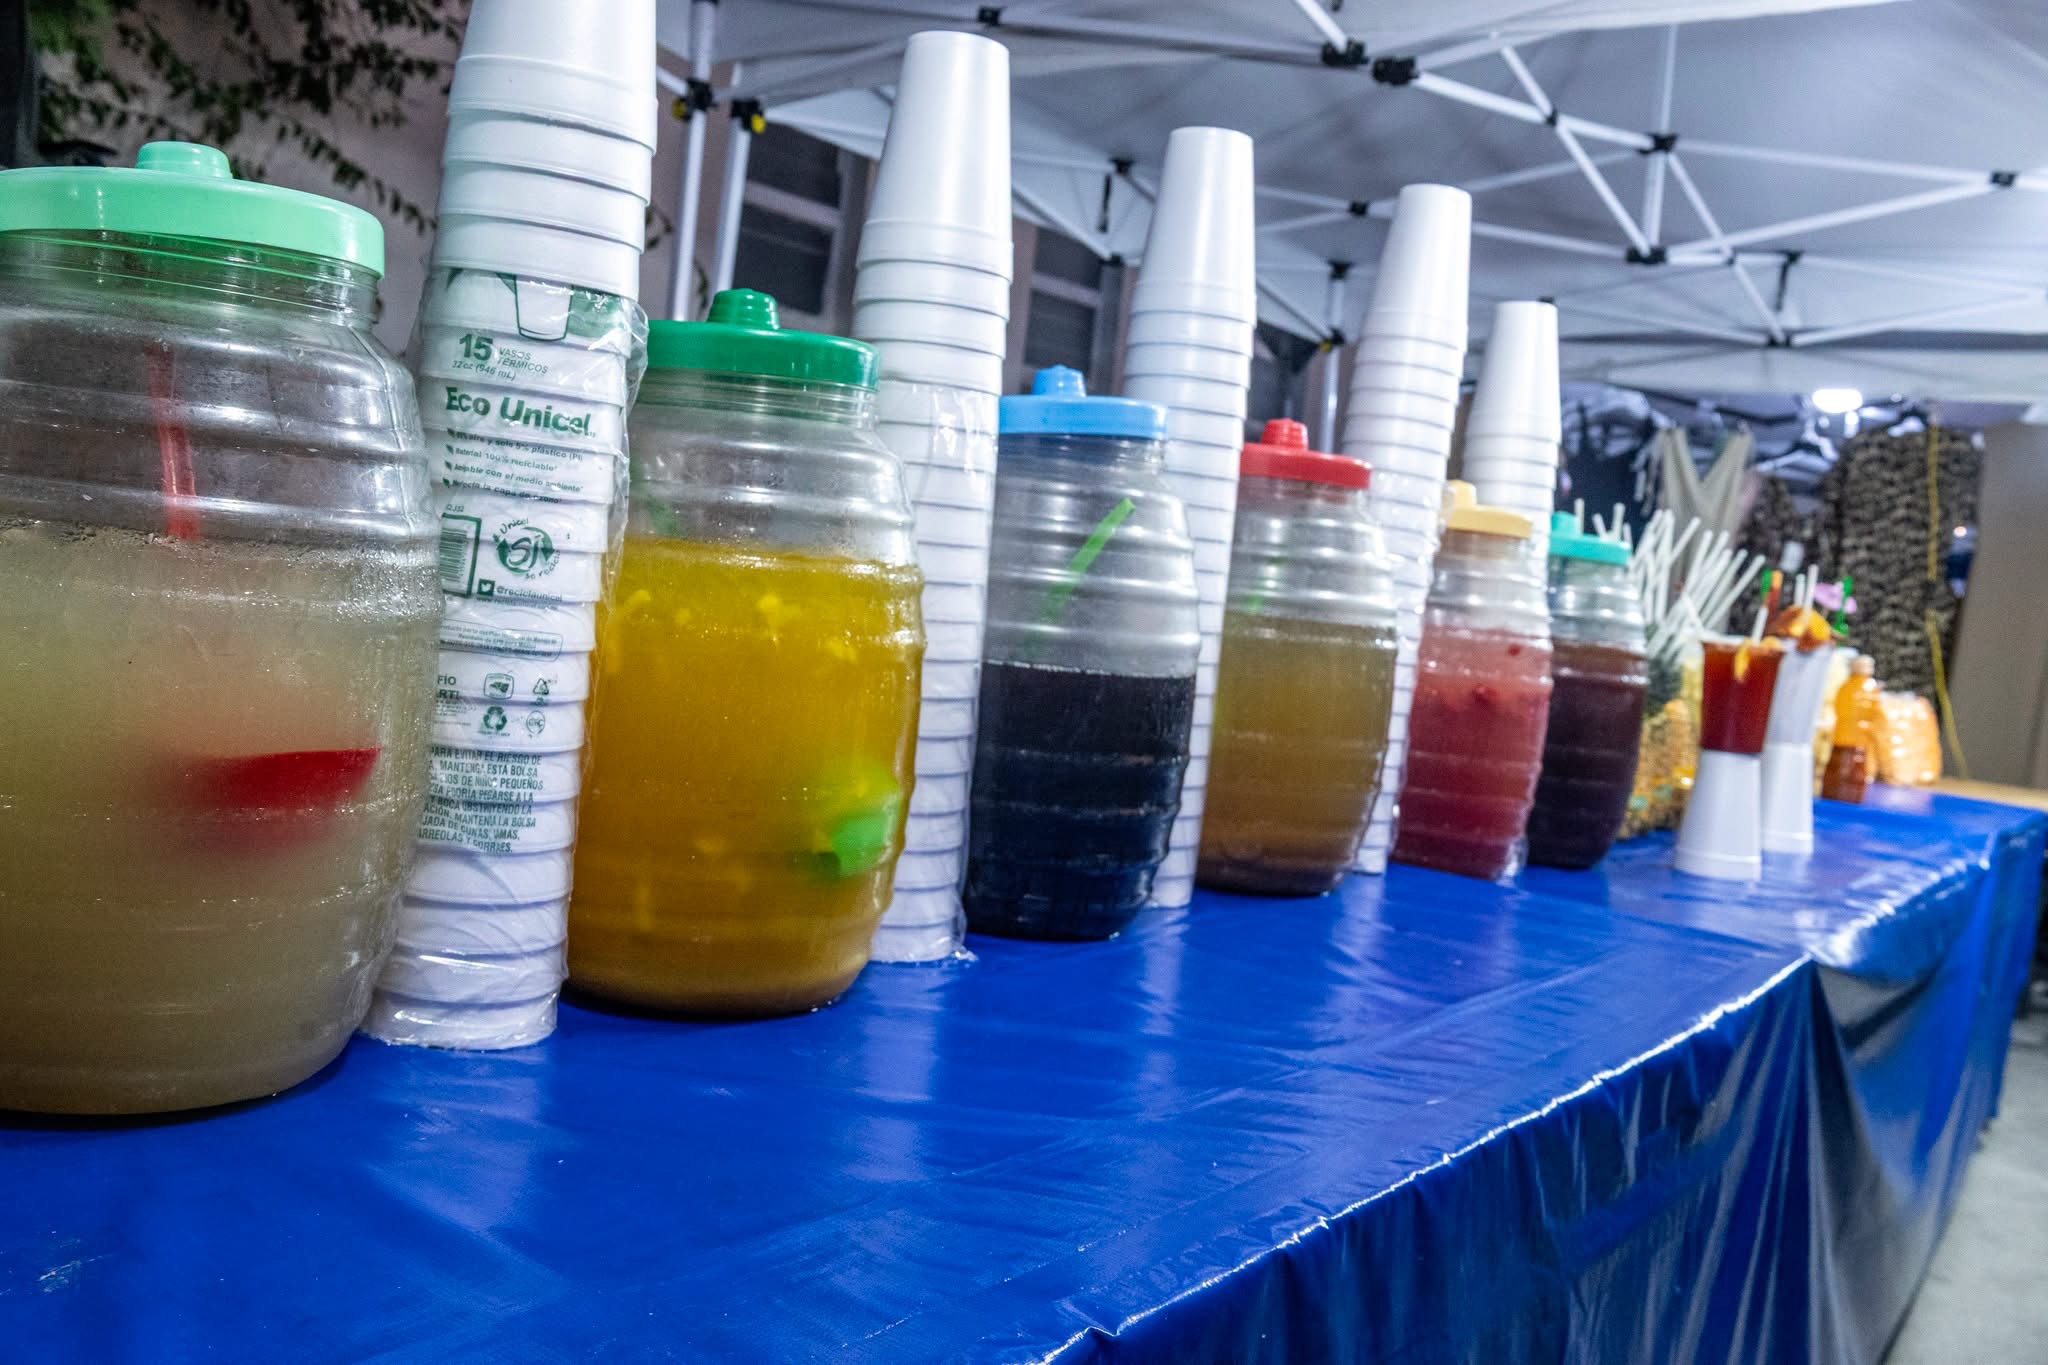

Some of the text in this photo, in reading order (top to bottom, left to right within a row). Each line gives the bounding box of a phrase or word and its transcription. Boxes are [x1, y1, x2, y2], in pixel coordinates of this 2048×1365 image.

[459, 333, 493, 361] 15
[499, 346, 531, 361] VASOS
[445, 386, 592, 437] Eco Unicel
[485, 469, 502, 478] con
[515, 475, 543, 486] medio
[531, 754, 543, 766] DE
[487, 763, 508, 776] ESTA
[511, 765, 538, 778] BOLSA
[461, 775, 473, 786] DE
[523, 791, 534, 804] LA
[447, 820, 458, 830] DE
[498, 815, 509, 827] LA
[511, 816, 537, 828] BOLSA
